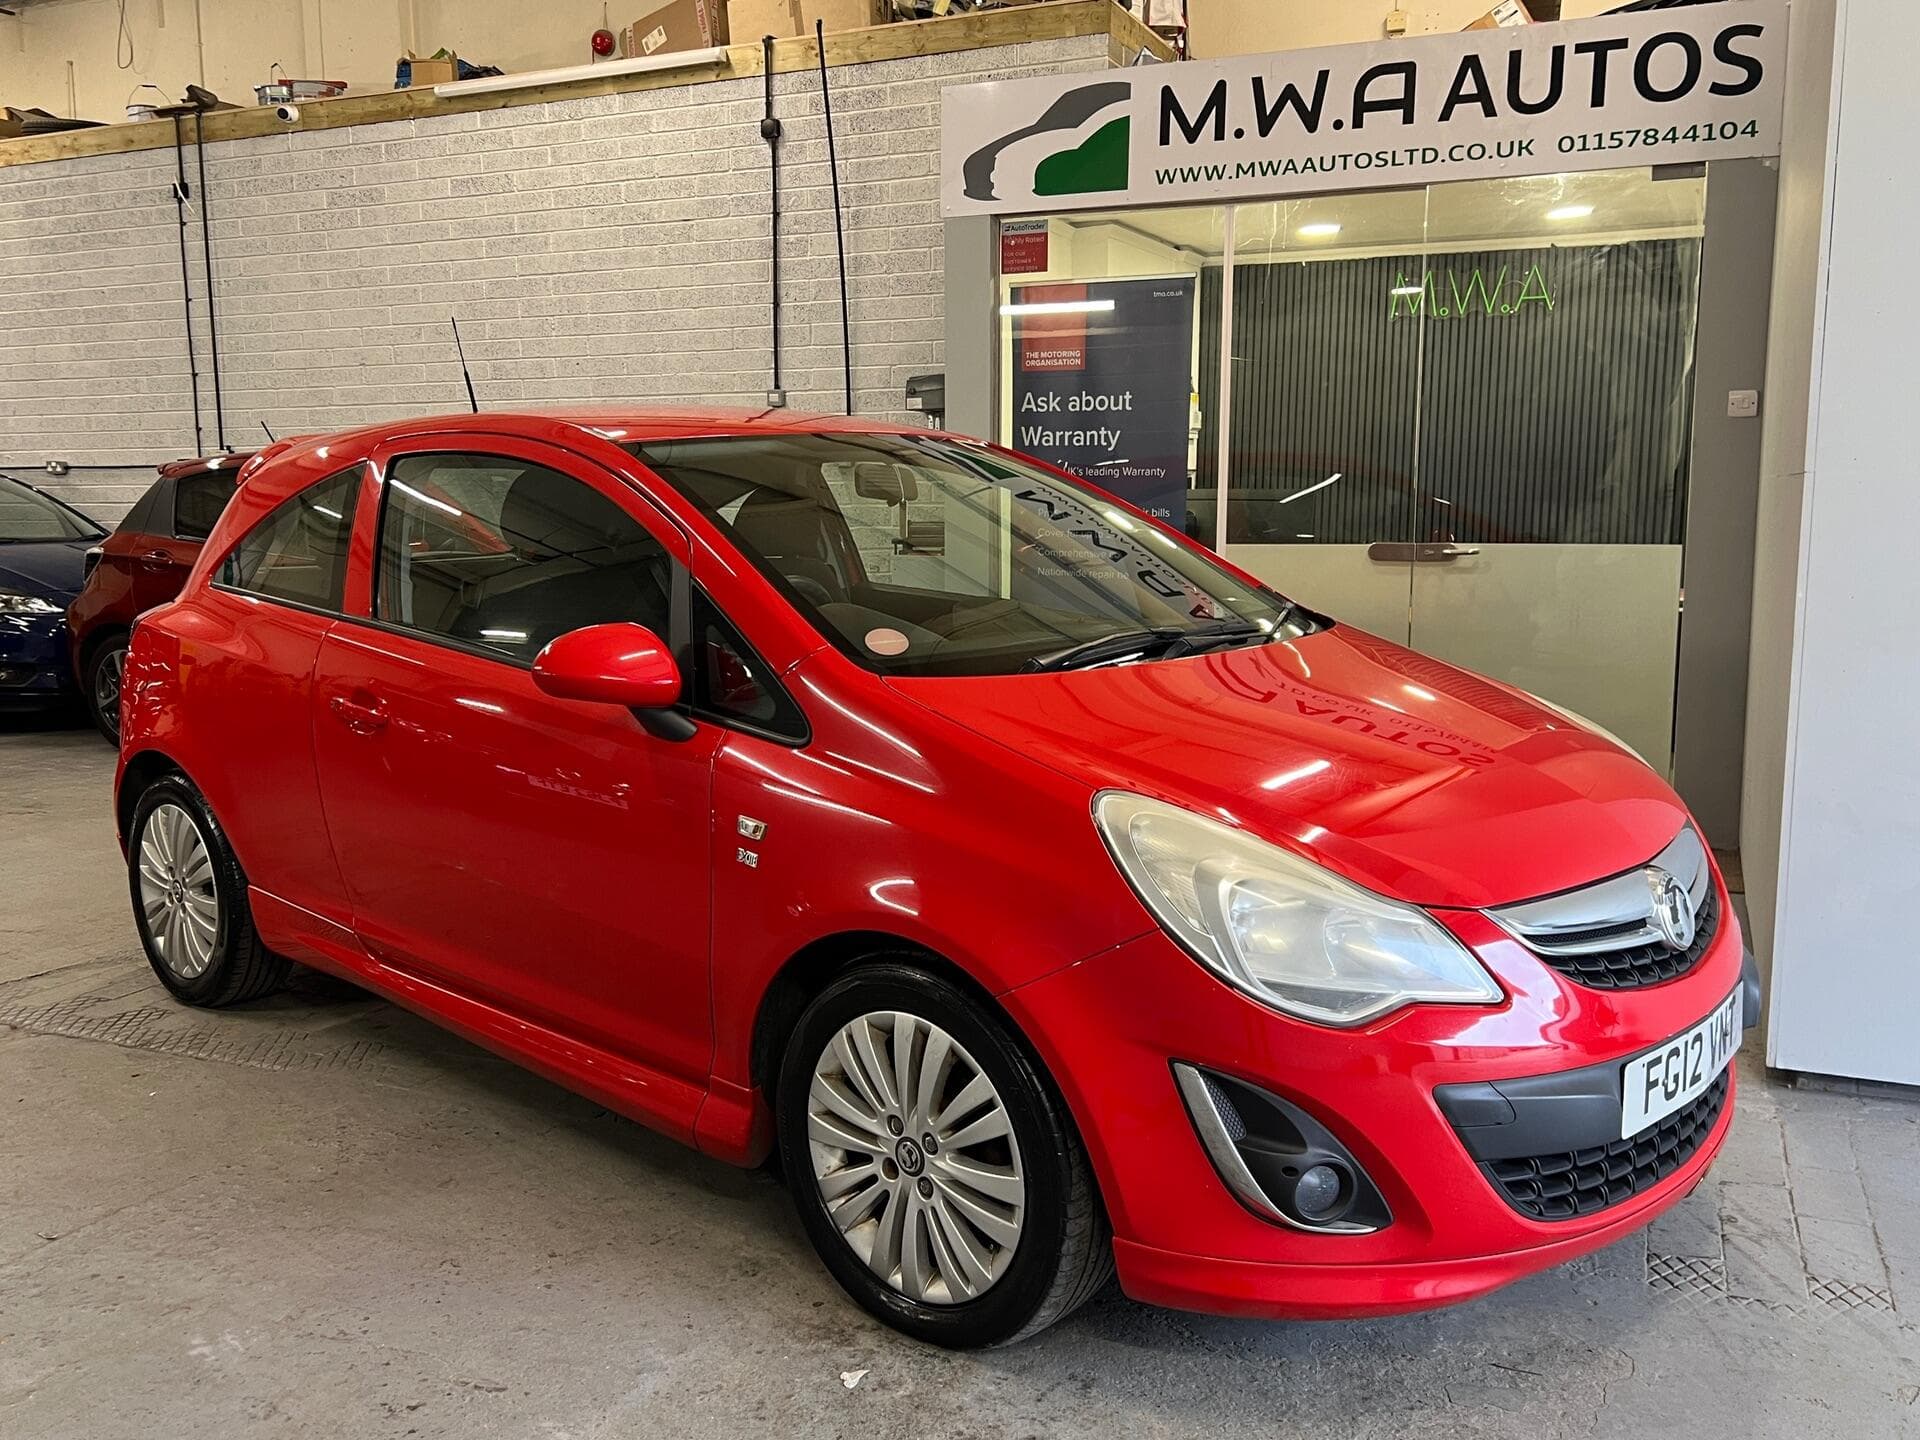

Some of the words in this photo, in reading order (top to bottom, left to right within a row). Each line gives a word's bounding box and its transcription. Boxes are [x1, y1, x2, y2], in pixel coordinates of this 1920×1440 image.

[1159, 61, 1417, 146] M.W.A
[1437, 24, 1764, 122] AUTOS
[1155, 138, 1535, 185] WWW.MWAAUTOSLTD.CO.UK
[1557, 119, 1759, 153] 01157844104
[1011, 223, 1045, 231] AutoTrader
[1025, 351, 1040, 359] THE
[1041, 350, 1081, 358] MOTORING
[1025, 358, 1081, 367] ORGANISATION
[1021, 391, 1062, 412] Ask
[1068, 391, 1132, 411] about
[1021, 425, 1121, 451] Warranty
[1086, 466, 1120, 479] leading
[1123, 465, 1166, 479] Warranty
[1151, 507, 1170, 518] bills
[1643, 1032, 1704, 1115] FG12
